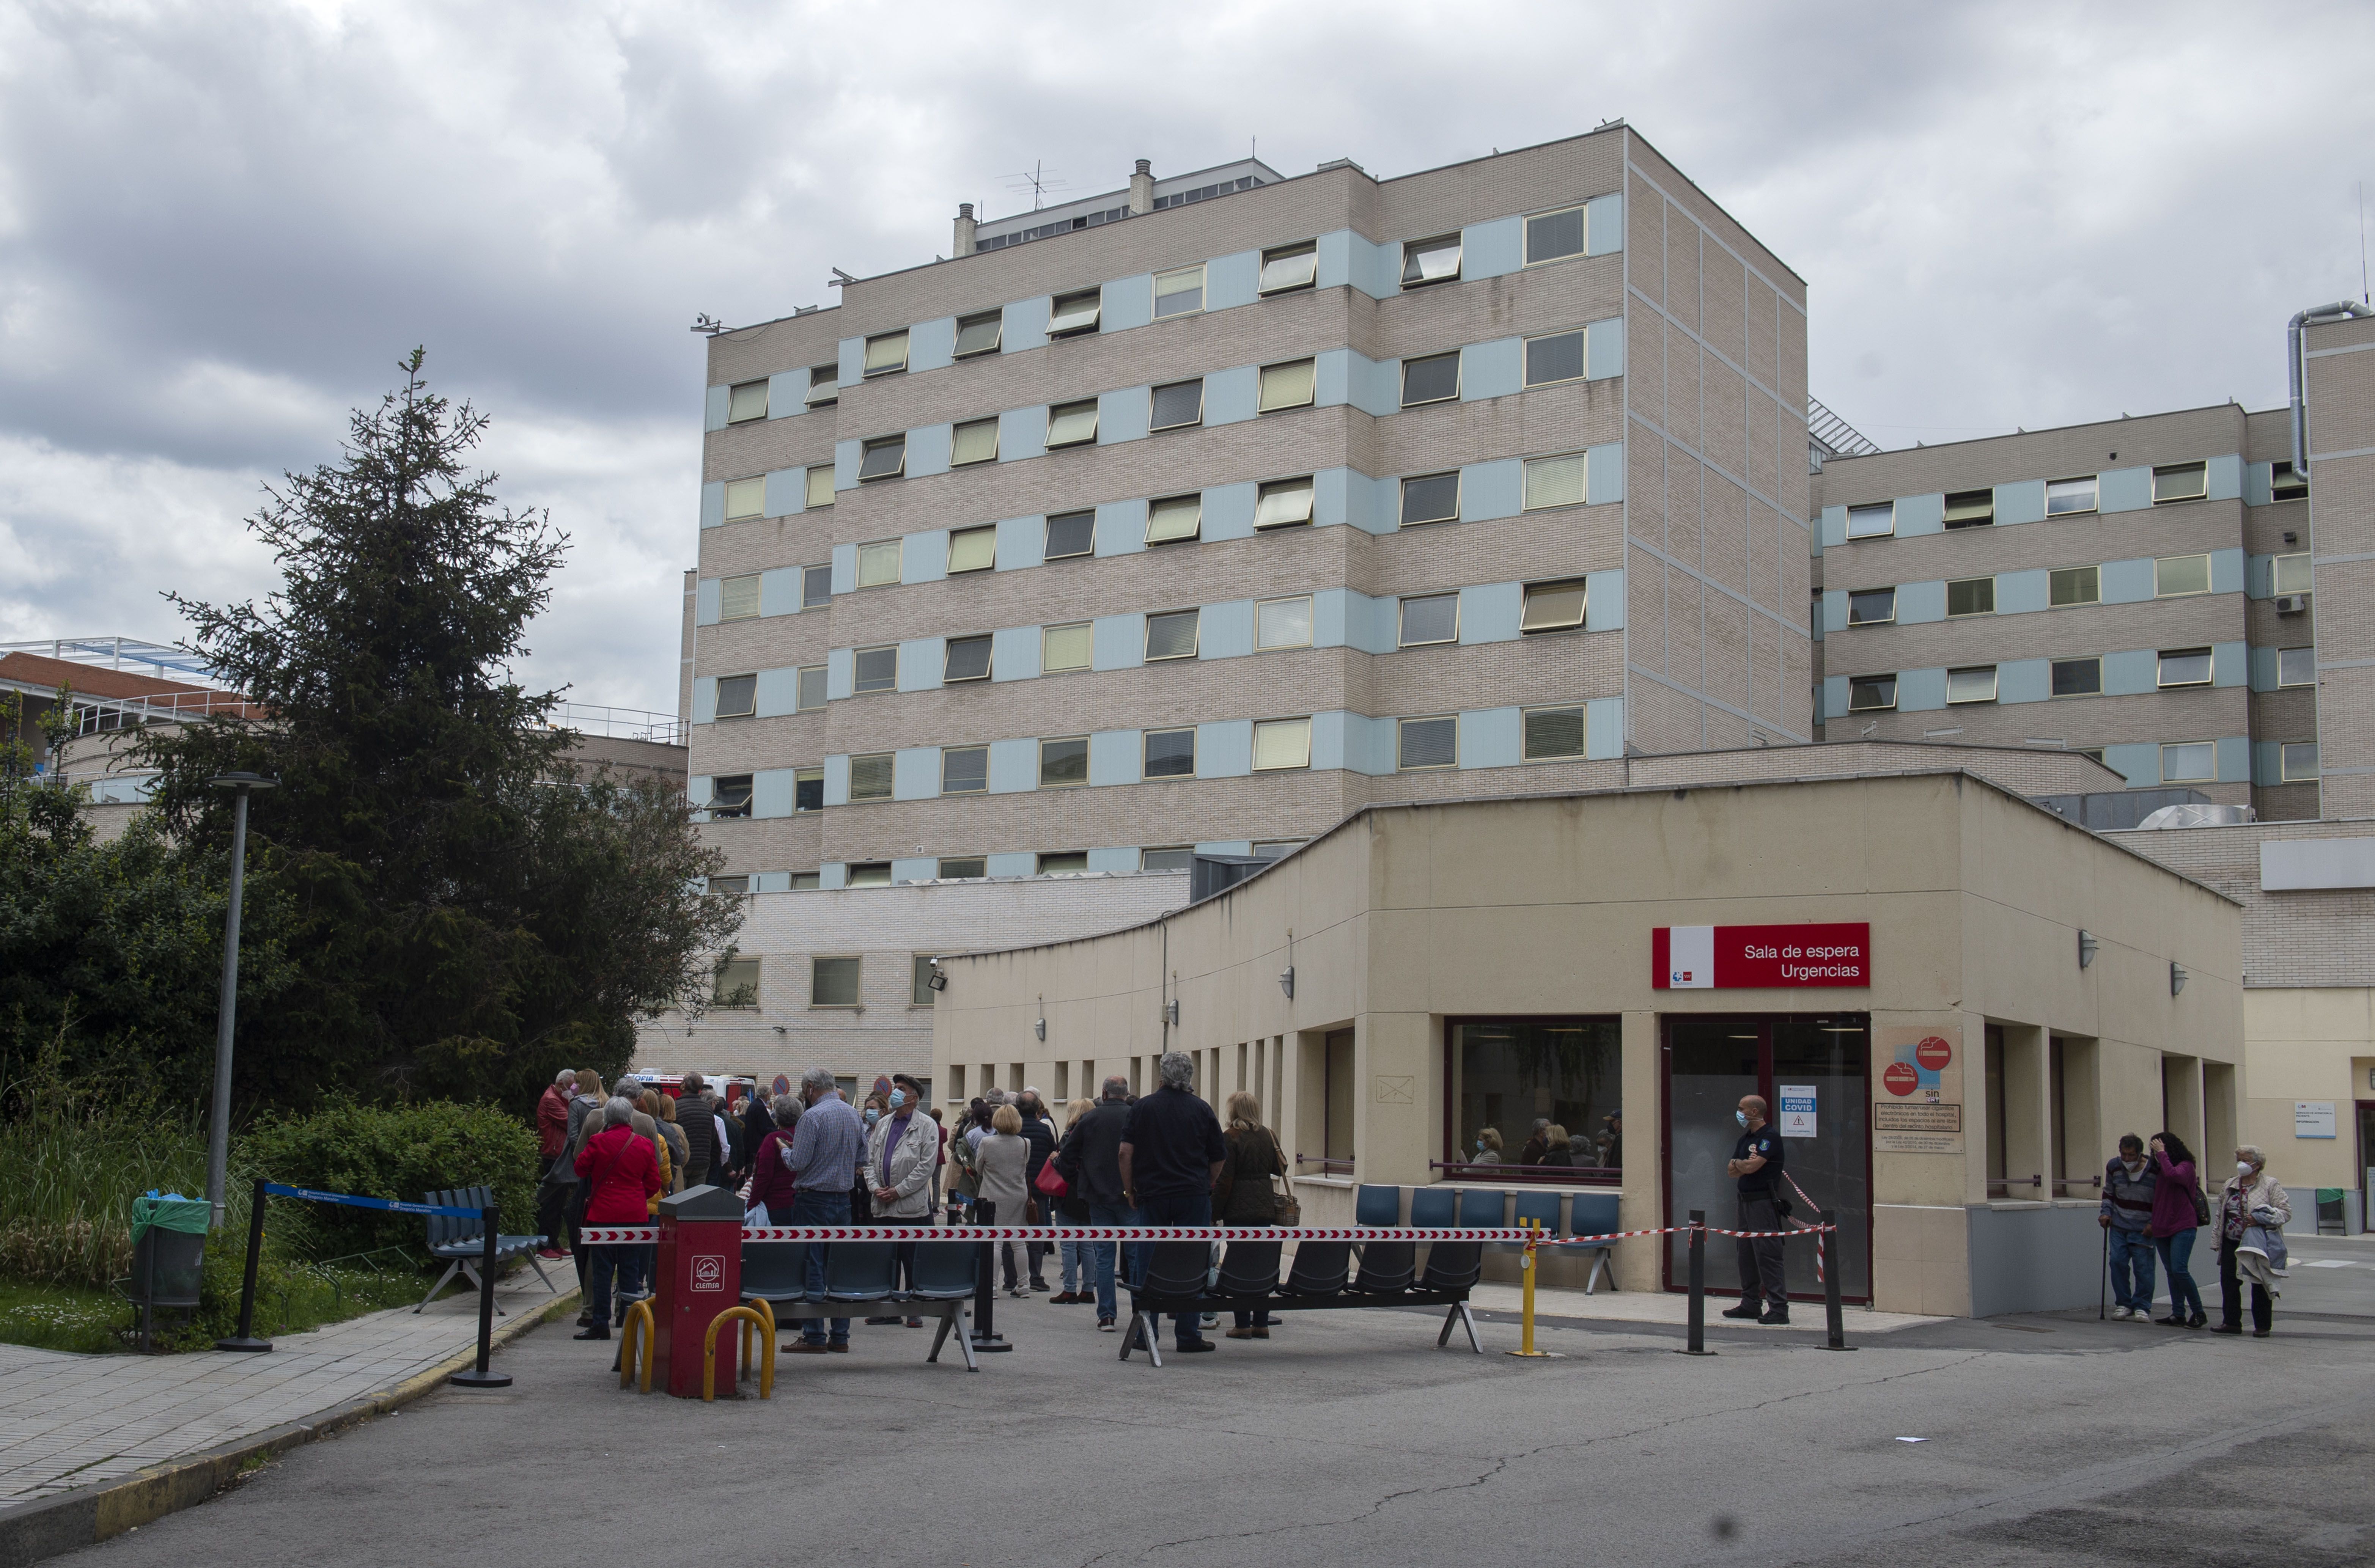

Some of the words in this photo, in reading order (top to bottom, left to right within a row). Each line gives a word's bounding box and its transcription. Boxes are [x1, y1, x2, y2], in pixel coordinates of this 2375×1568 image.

[1745, 945, 1777, 958] Sala
[1782, 945, 1801, 958] de
[1806, 946, 1859, 960] espera
[1782, 963, 1859, 980] Urgencias
[1925, 1089, 1939, 1097] sin
